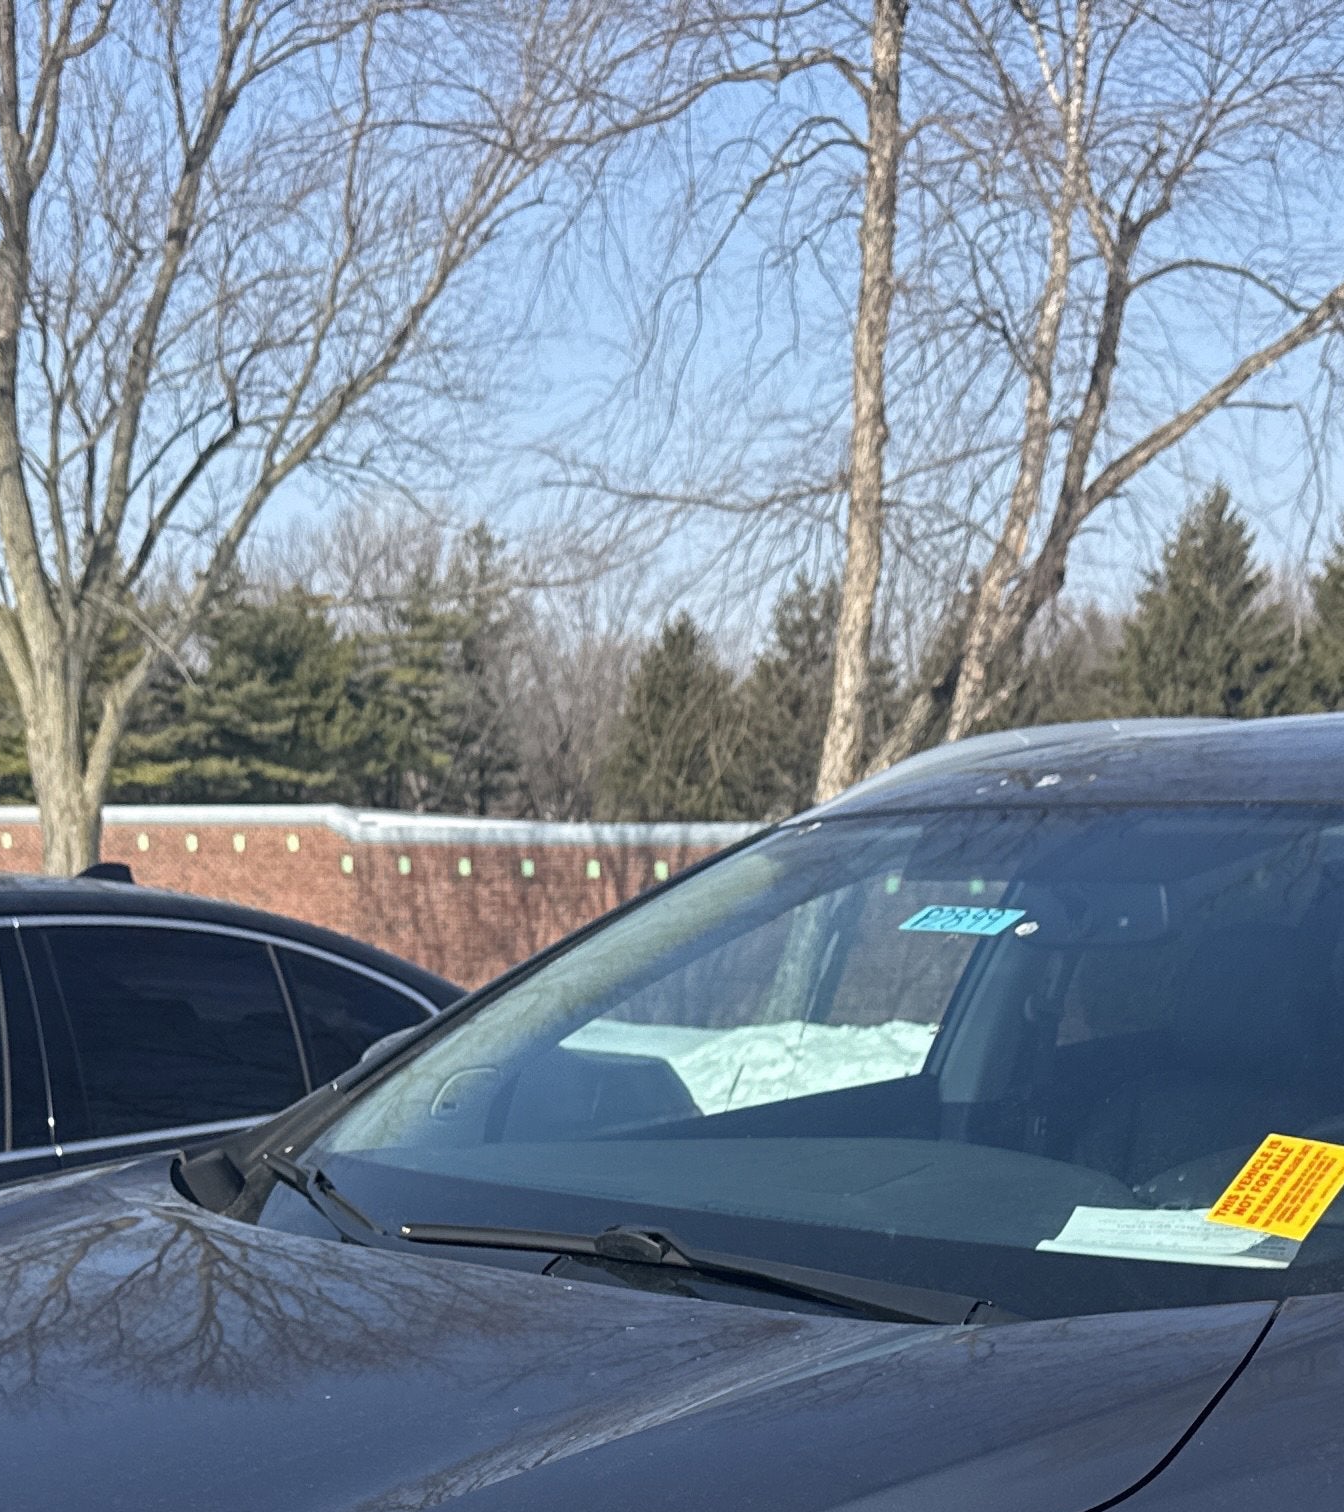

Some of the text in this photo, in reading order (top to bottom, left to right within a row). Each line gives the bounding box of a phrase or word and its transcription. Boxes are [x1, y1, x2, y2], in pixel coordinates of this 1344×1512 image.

[1214, 1140, 1282, 1218] THIS VEHICLE IS
[1232, 1146, 1294, 1216] NOT FOR SALE
